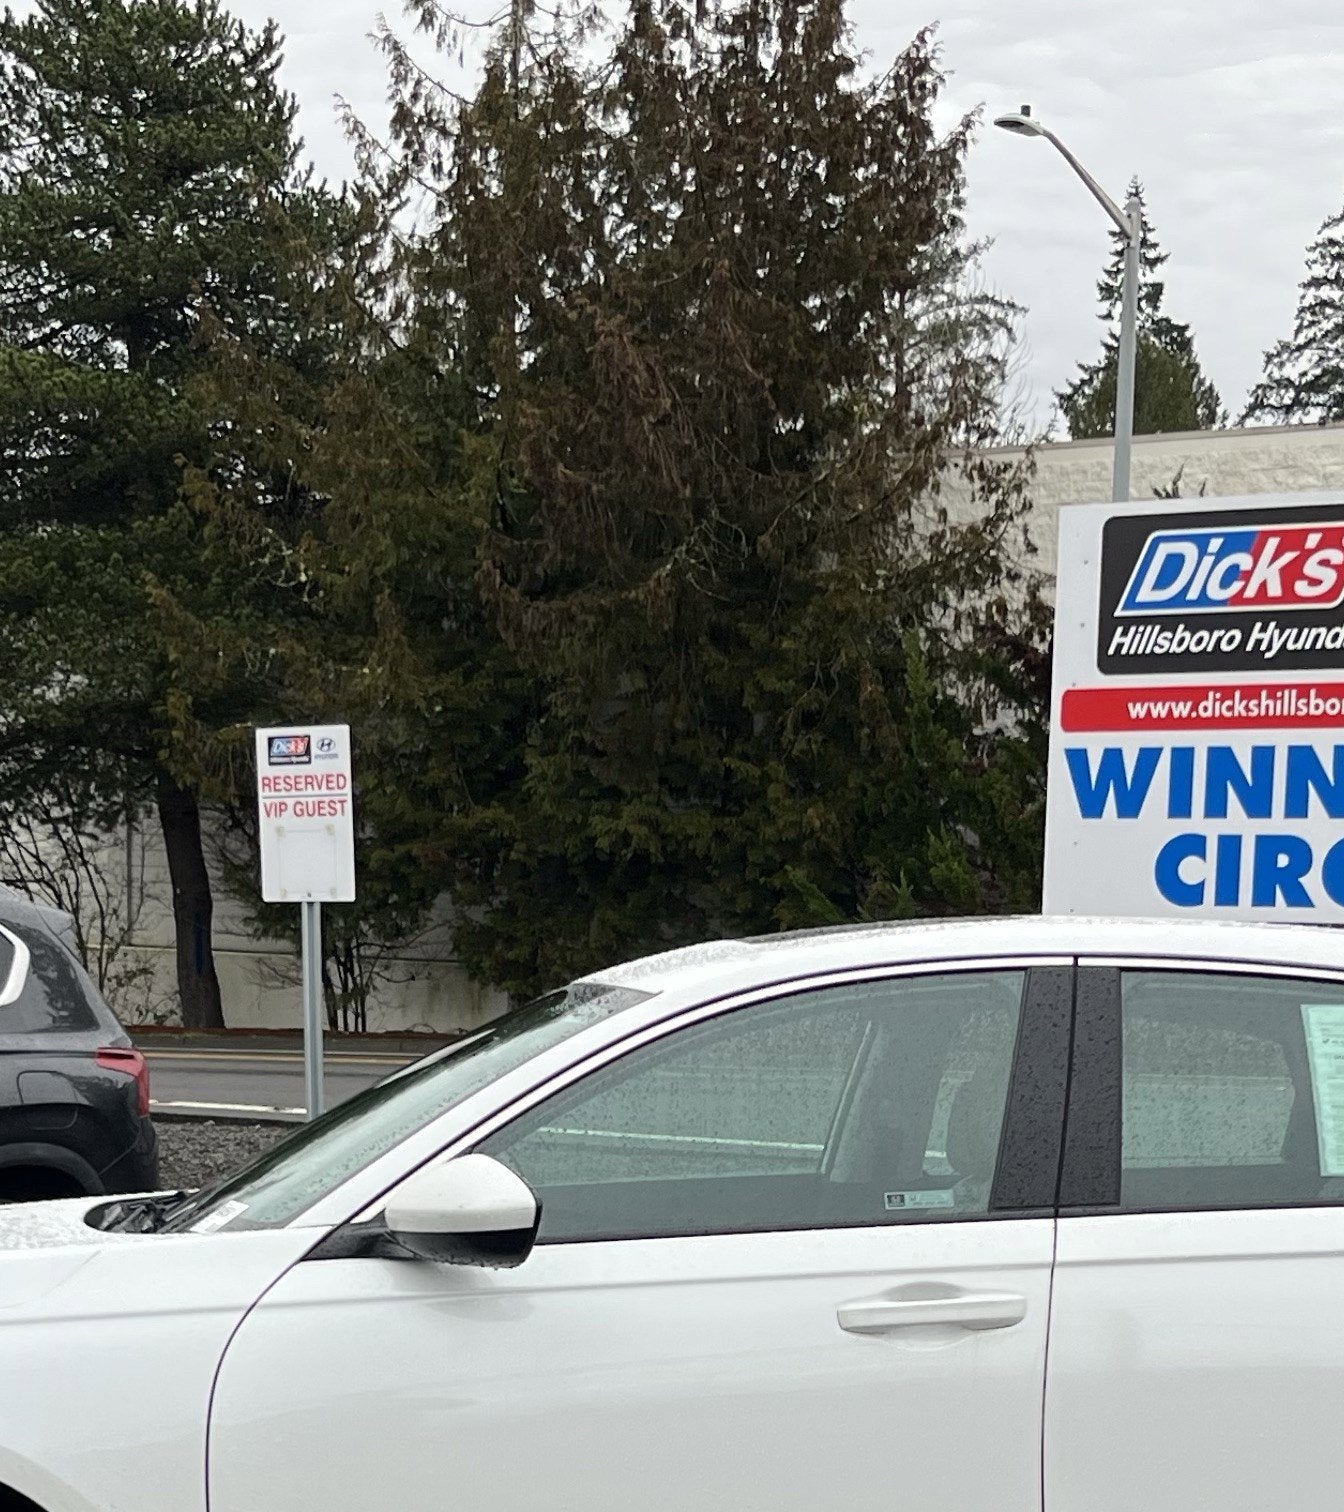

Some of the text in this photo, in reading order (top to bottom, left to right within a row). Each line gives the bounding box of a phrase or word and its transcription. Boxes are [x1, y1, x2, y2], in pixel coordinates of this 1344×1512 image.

[1107, 621, 1241, 656] Hillsboro
[262, 773, 347, 793] RESERVED
[264, 799, 348, 818] VIP GUEST
